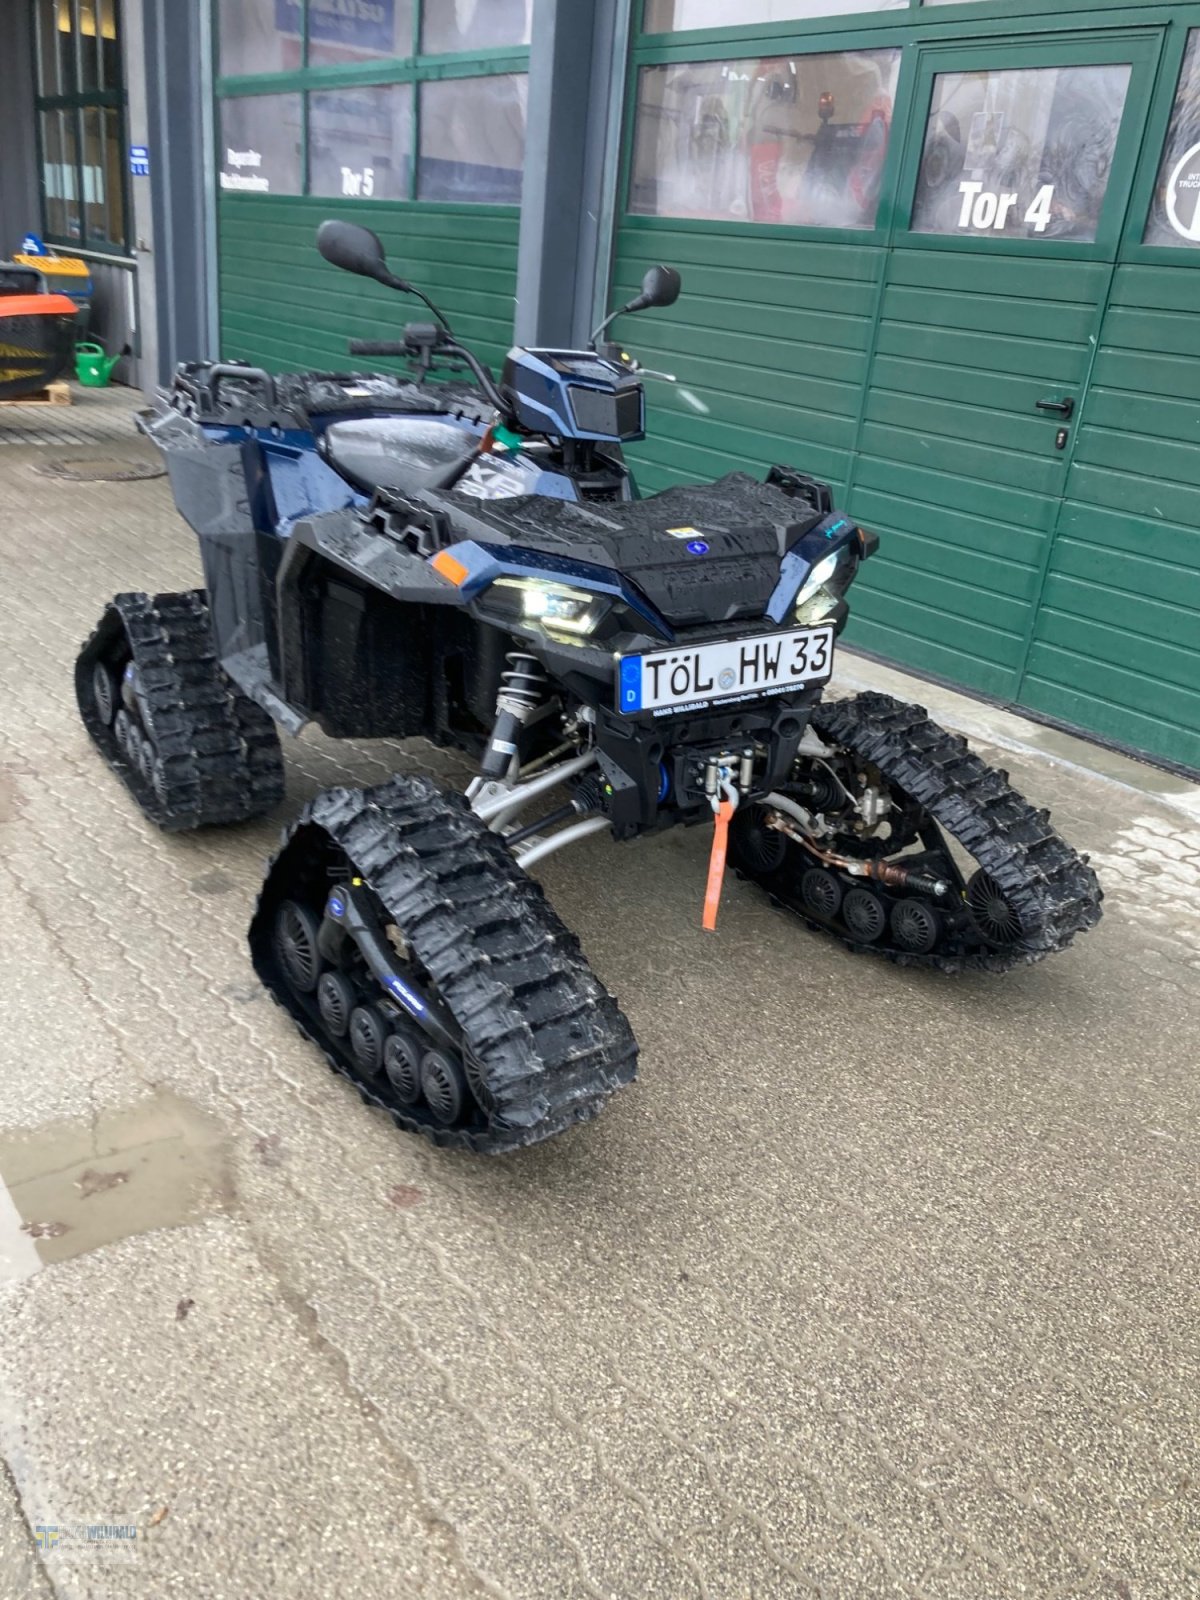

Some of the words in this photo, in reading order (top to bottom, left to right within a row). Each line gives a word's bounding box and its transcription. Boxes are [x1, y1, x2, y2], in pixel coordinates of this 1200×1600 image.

[341, 167, 362, 197] Tor
[363, 167, 375, 197] 5
[958, 181, 1018, 230] Tor
[1023, 184, 1055, 232] 4
[646, 653, 713, 700] TÖL
[739, 641, 782, 685] HW
[790, 633, 829, 676] 33
[626, 689, 636, 703] D
